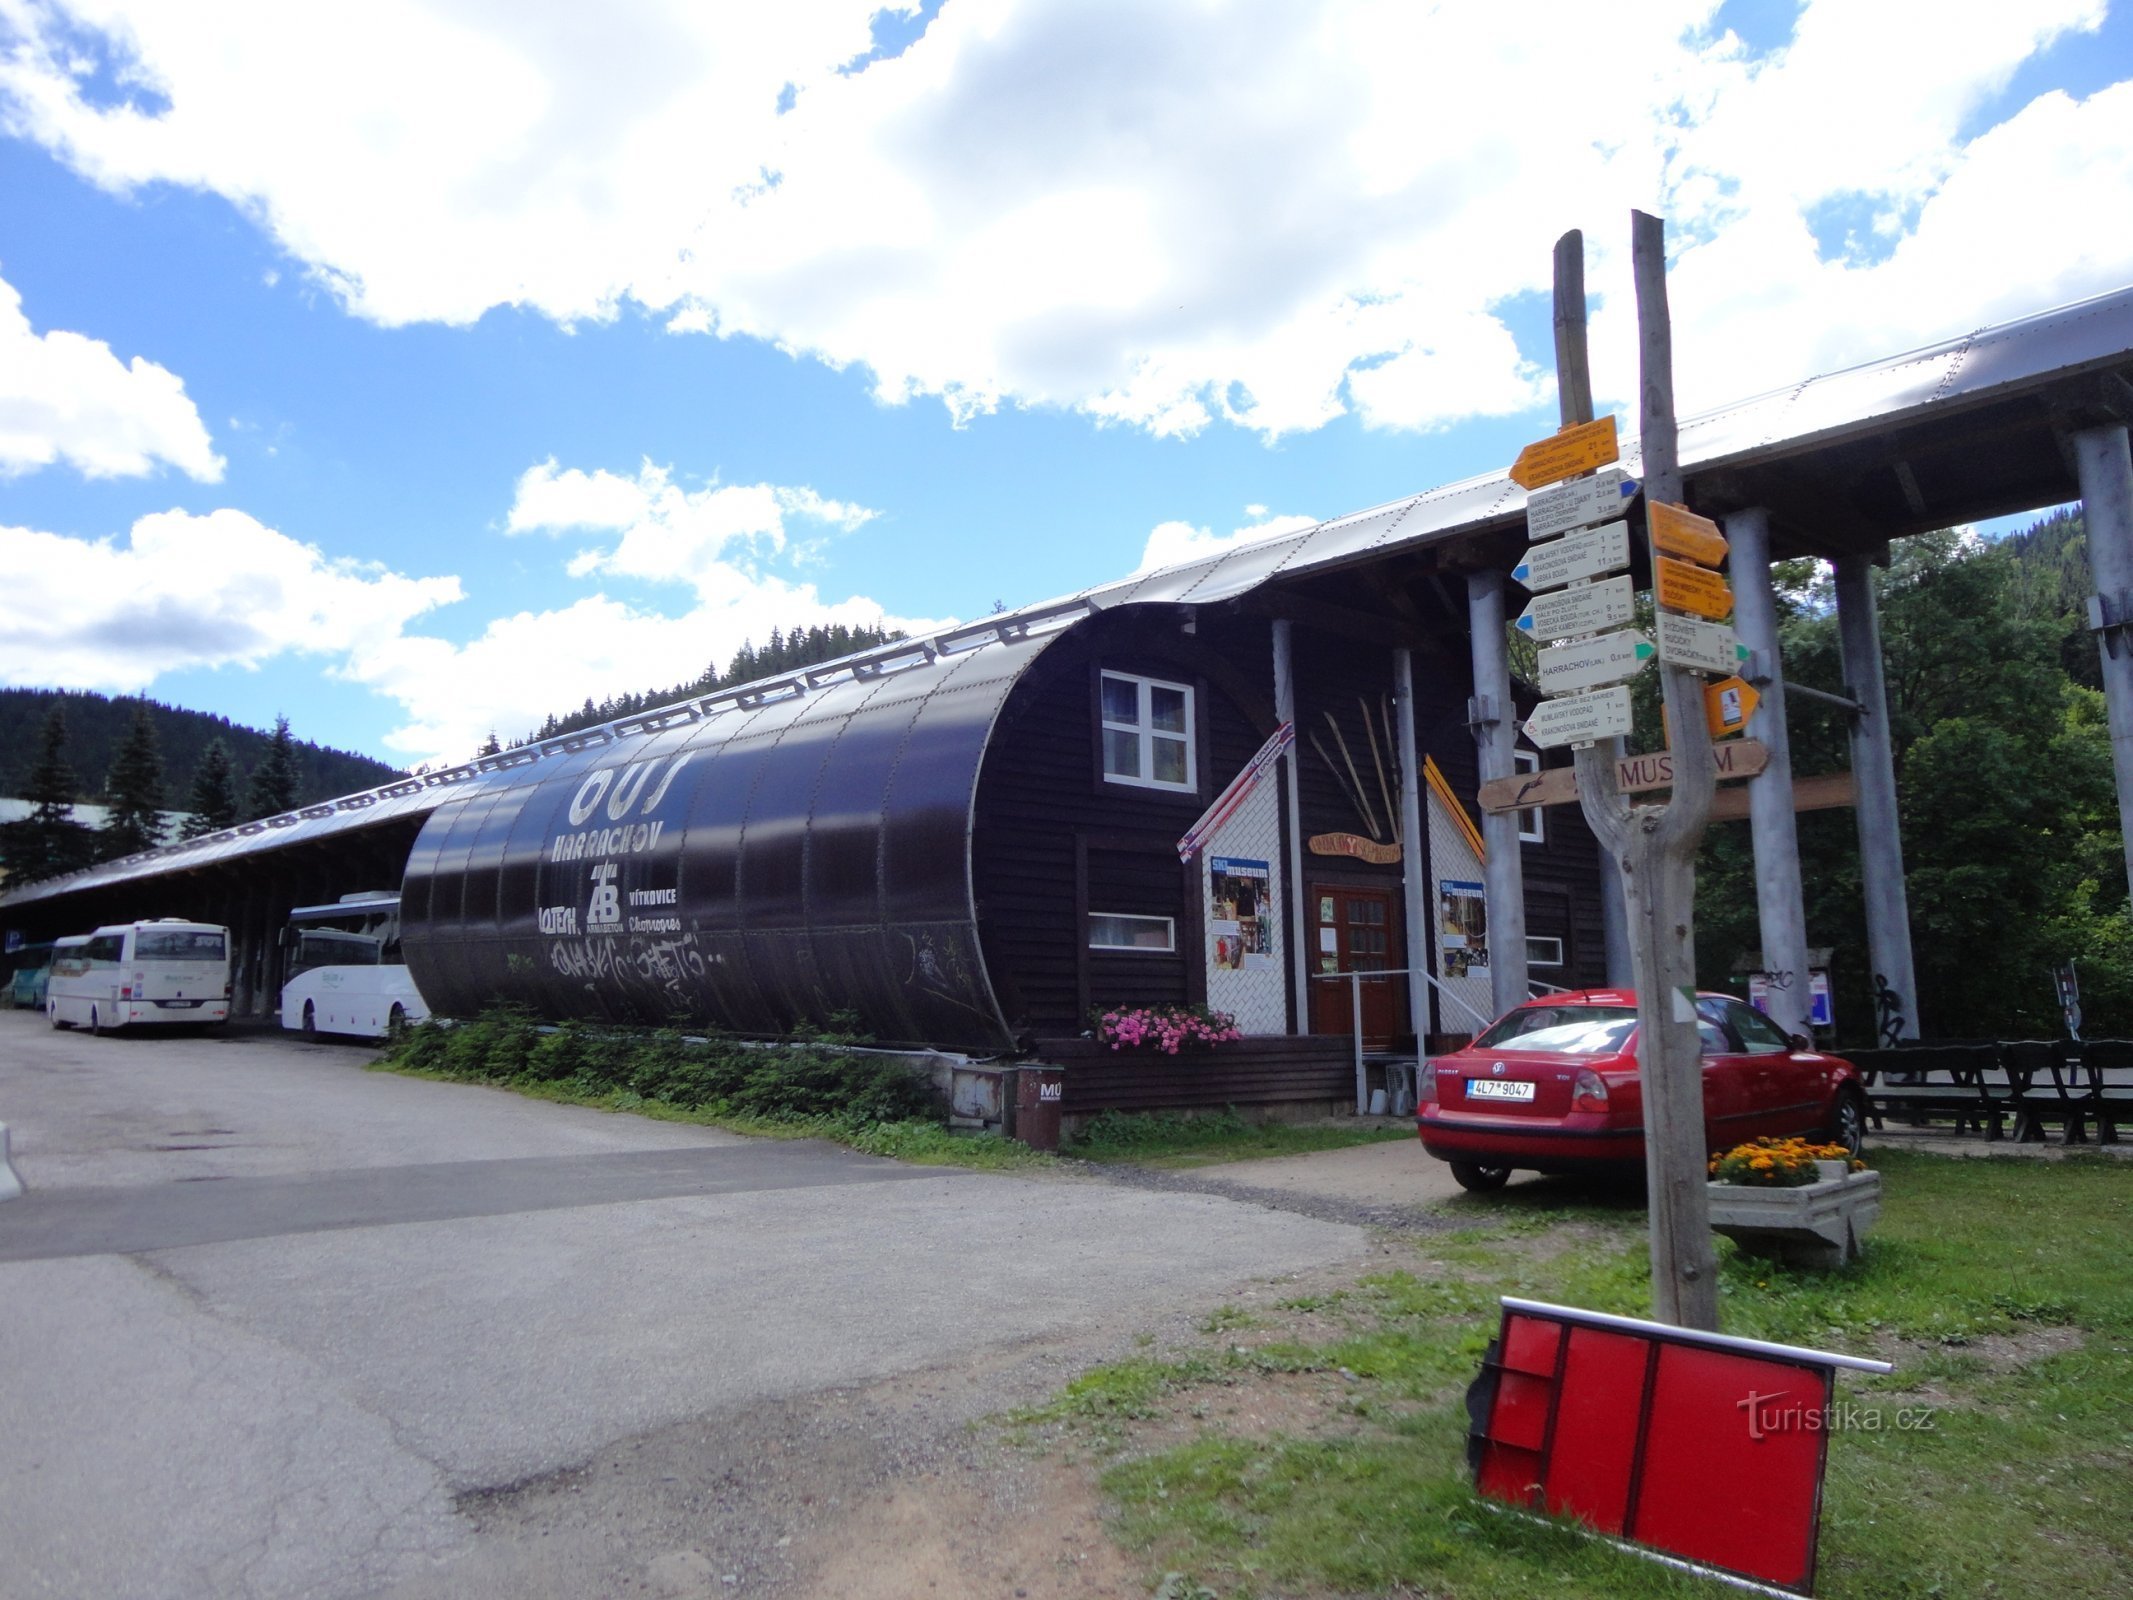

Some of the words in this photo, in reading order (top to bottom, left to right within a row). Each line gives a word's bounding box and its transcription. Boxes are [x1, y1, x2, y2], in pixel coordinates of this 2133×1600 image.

[1611, 532, 1620, 540] km
[1605, 603, 1611, 611] 9
[1606, 702, 1610, 710] 1
[1606, 716, 1612, 724] 7
[1619, 746, 1734, 788] MUSM
[551, 821, 664, 863] HARRACHOV
[1212, 859, 1228, 871] SKI
[1226, 865, 1268, 879] museum
[629, 888, 677, 906] VÍTKOVICE
[1441, 882, 1454, 892] SKI
[1452, 888, 1483, 898] museum
[1475, 1082, 1495, 1095] 4L7
[1502, 1083, 1529, 1097] 9047
